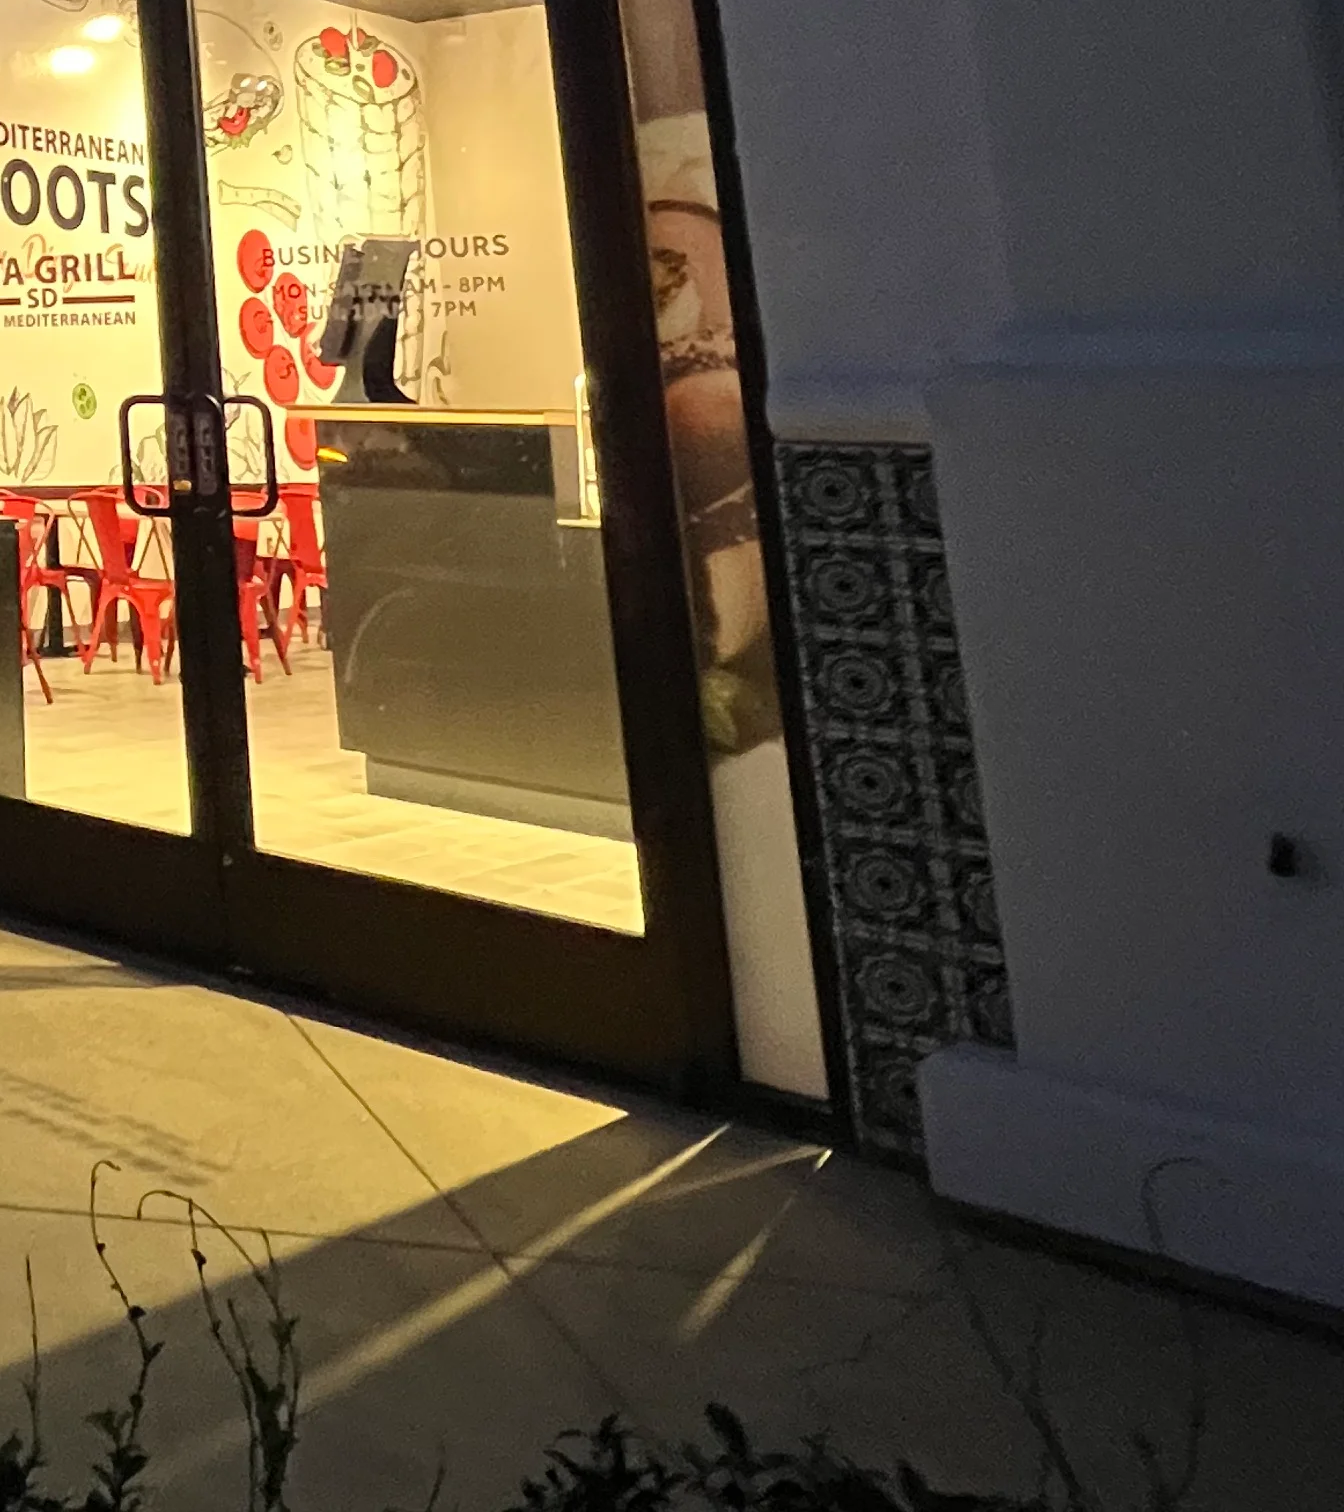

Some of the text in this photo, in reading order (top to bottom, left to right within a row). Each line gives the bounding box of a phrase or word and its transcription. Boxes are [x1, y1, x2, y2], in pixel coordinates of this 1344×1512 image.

[34, 250, 136, 284] GRILL
[458, 276, 506, 294] 8PM
[26, 287, 58, 309] SD
[430, 300, 478, 319] 7PM
[3, 310, 136, 329] MEDITERRANEAN
